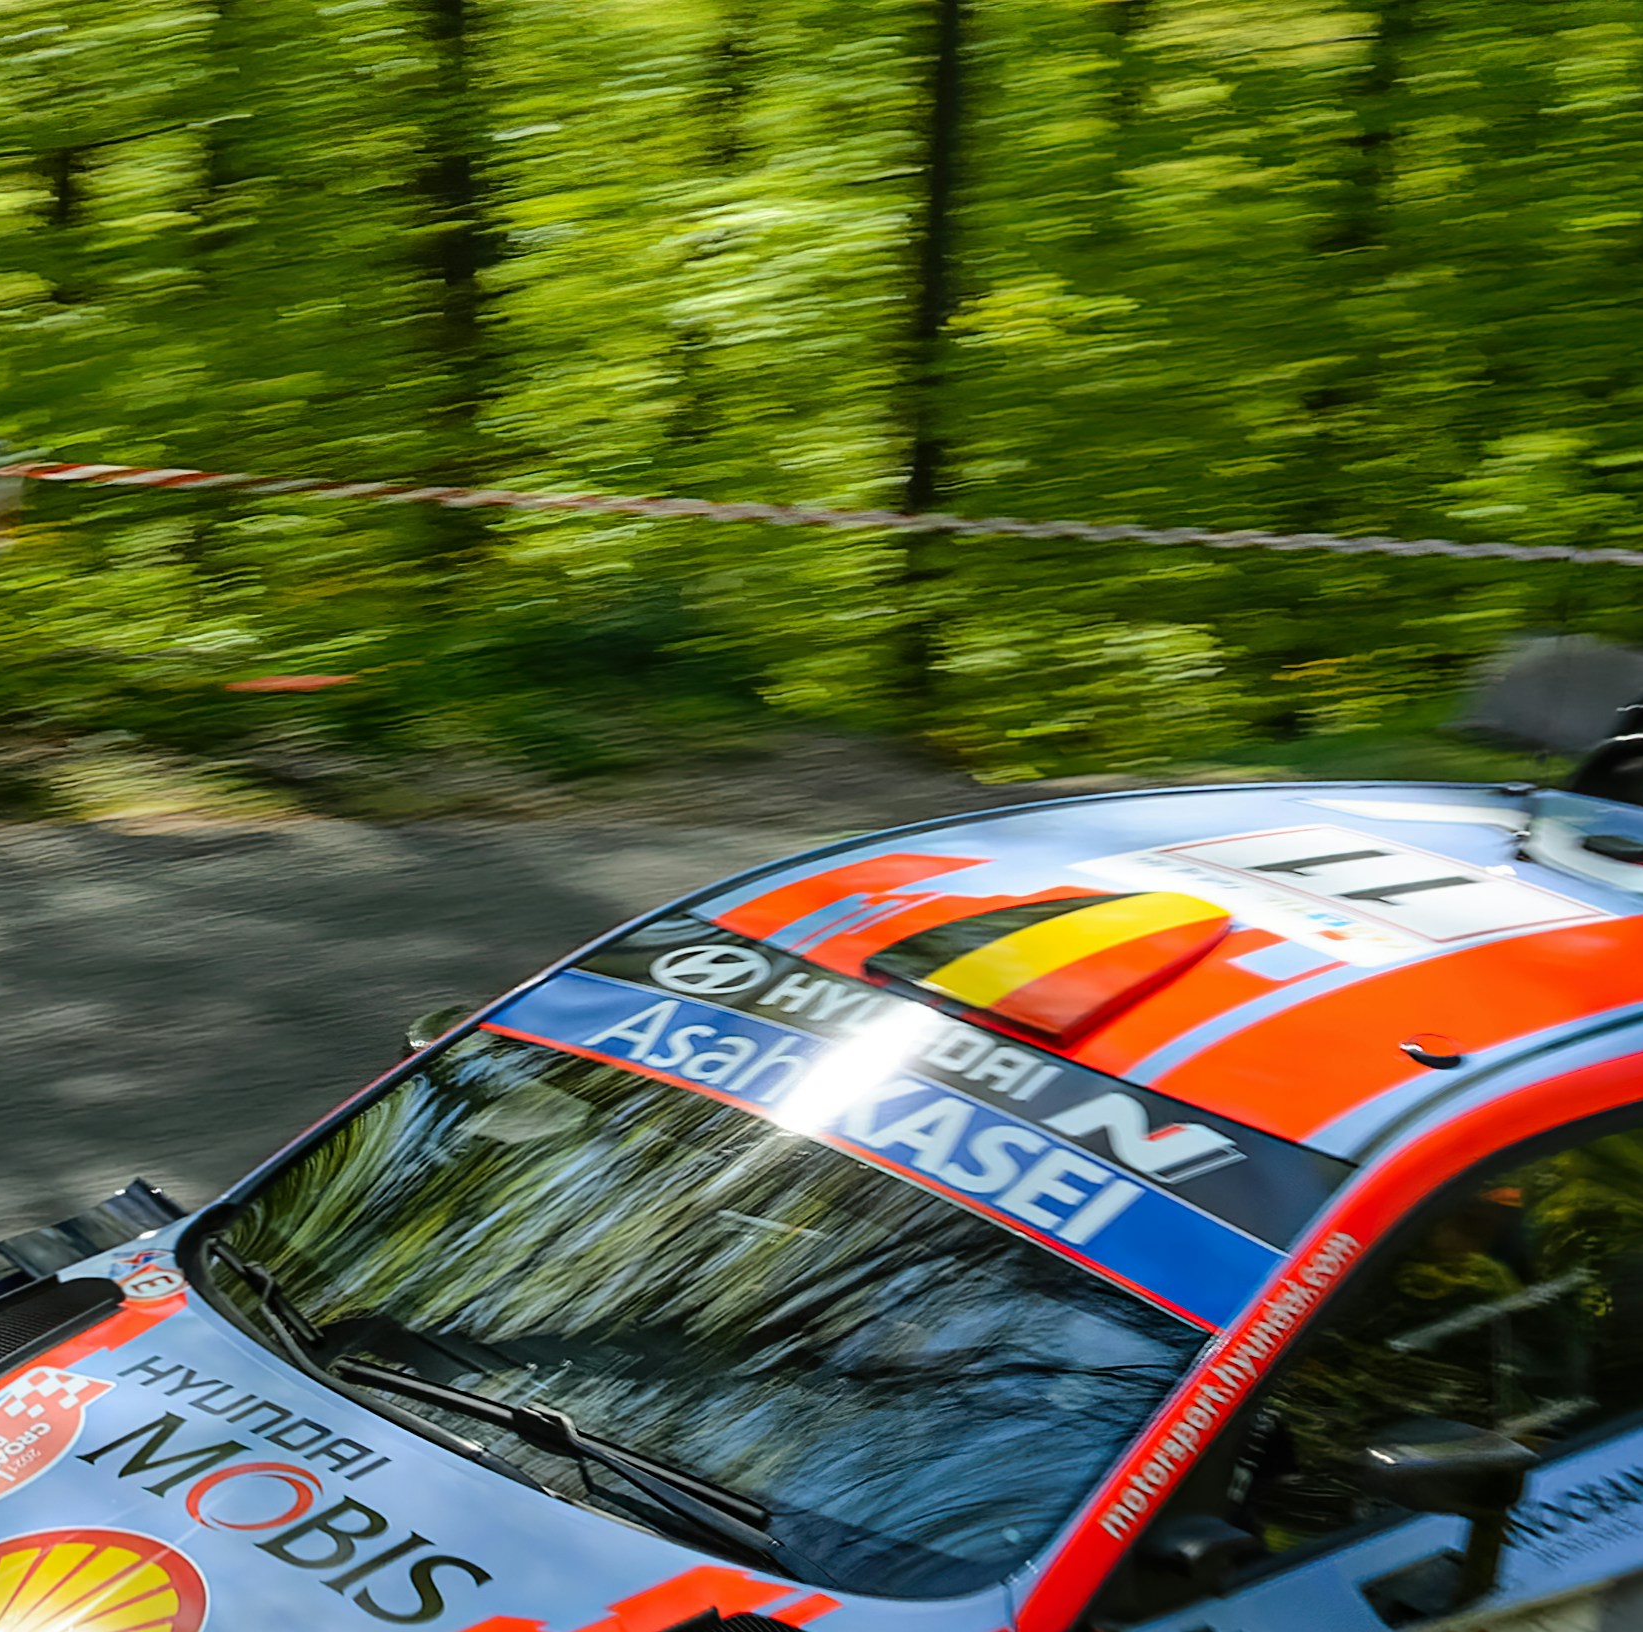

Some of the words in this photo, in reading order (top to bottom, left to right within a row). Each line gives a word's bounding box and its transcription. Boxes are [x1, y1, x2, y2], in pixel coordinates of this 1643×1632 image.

[582, 999, 820, 1108] Asah
[756, 972, 1064, 1102] HYDAI
[116, 1354, 392, 1483] HYUNDAI
[76, 1413, 494, 1627] MOBIS
